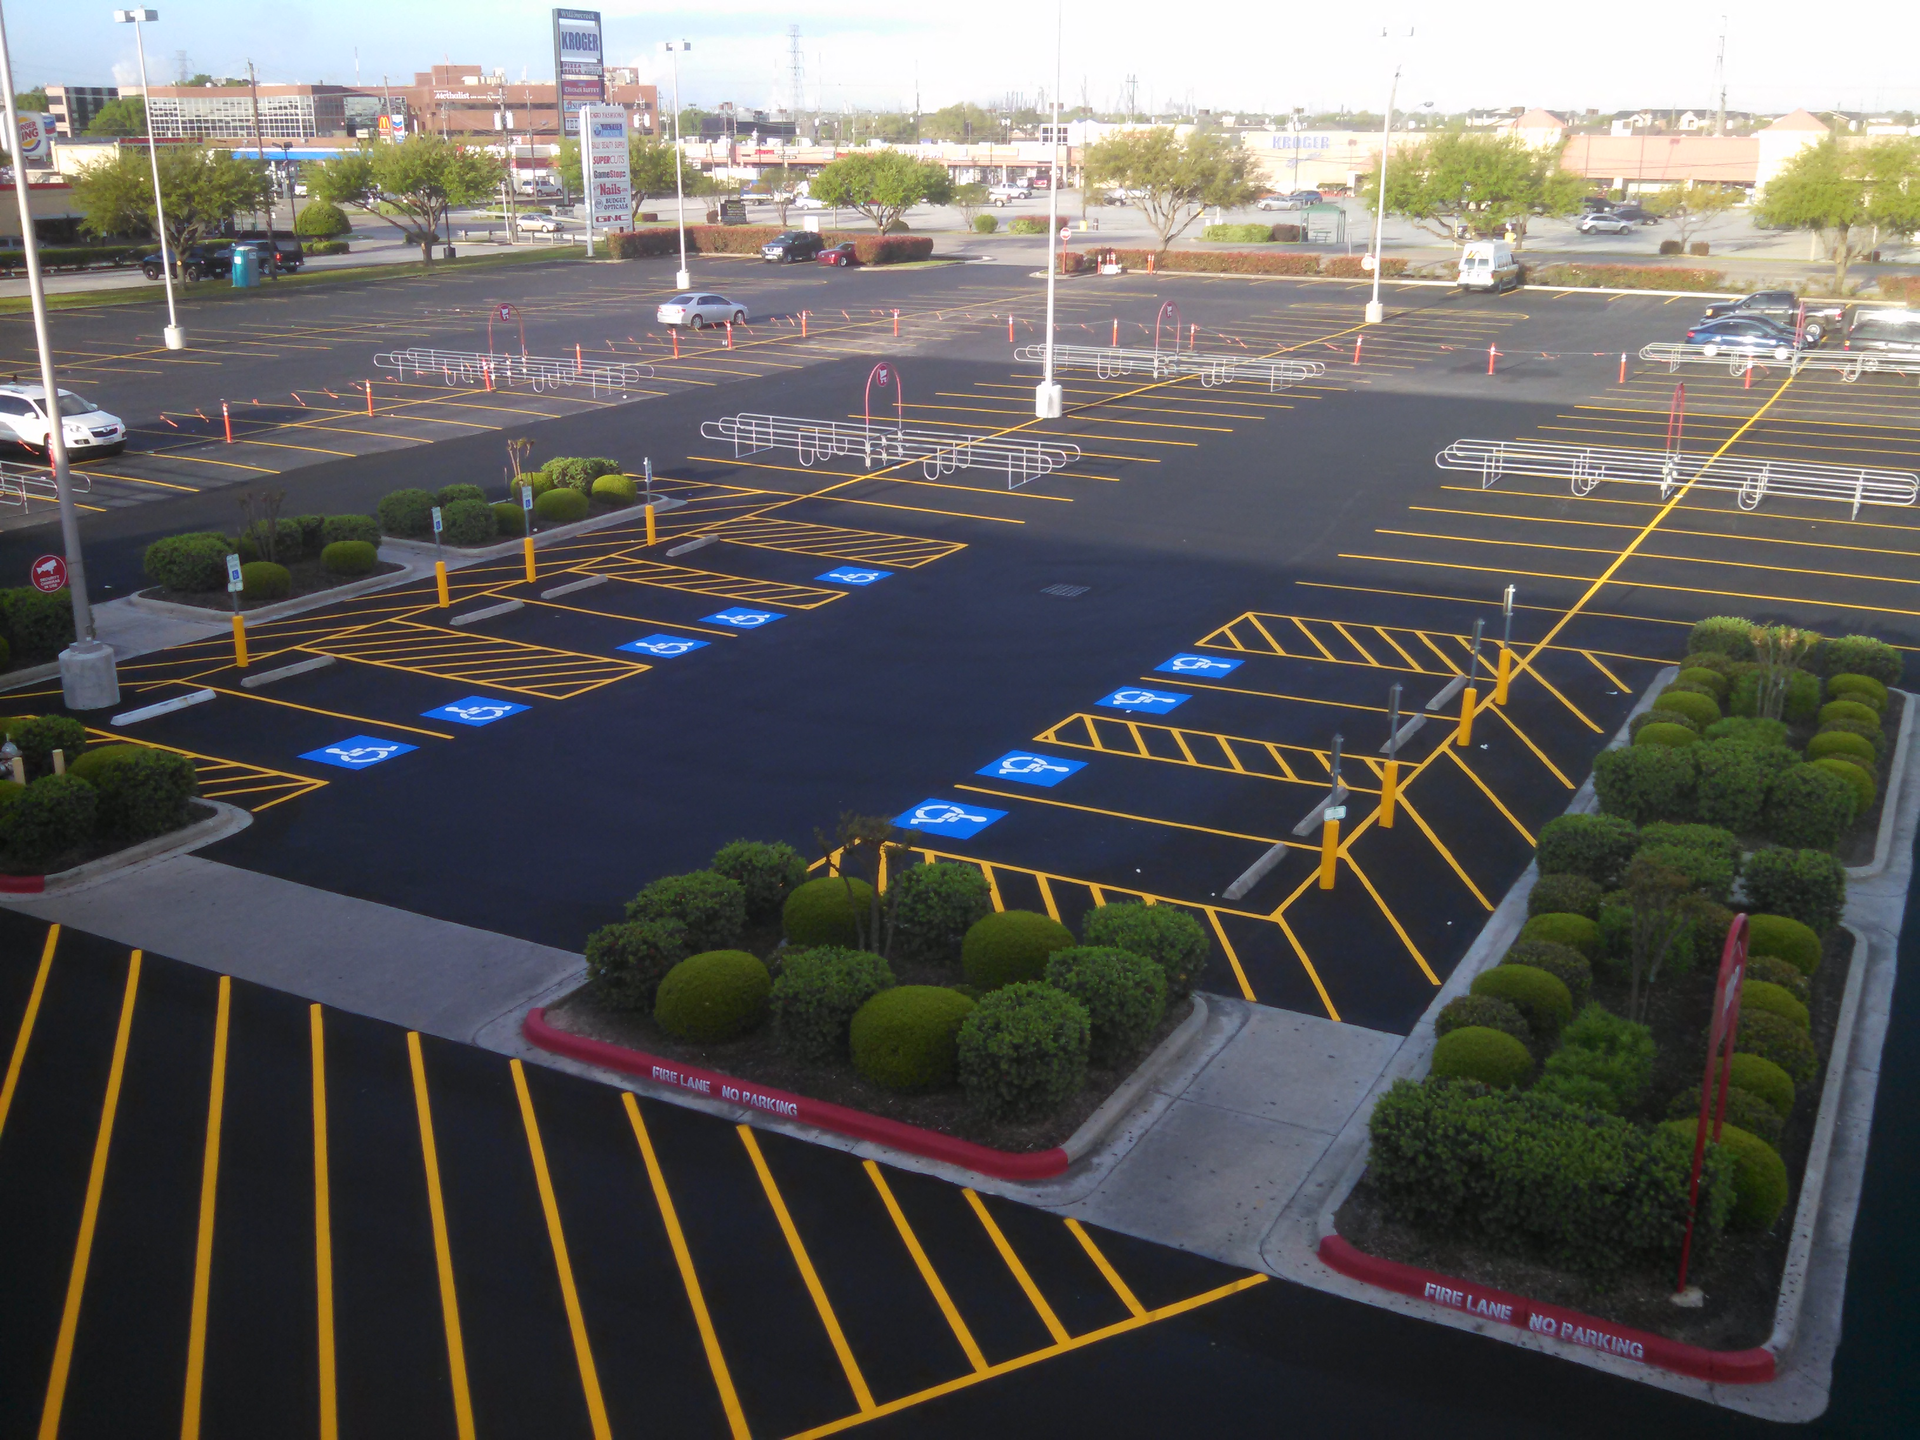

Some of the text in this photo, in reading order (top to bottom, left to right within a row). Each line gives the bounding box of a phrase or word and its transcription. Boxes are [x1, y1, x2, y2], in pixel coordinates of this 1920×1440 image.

[562, 32, 598, 52] KROGER
[22, 128, 38, 141] ING
[1272, 136, 1329, 149] KROGER
[593, 155, 624, 164] SUPERCUTS
[594, 170, 626, 179] GameStop
[600, 183, 621, 195] Nails
[596, 214, 629, 222] GNC
[652, 1066, 798, 1116] FIRE LANE NO PARKING
[1424, 1282, 1644, 1358] FIRE LANE NO PARKING
